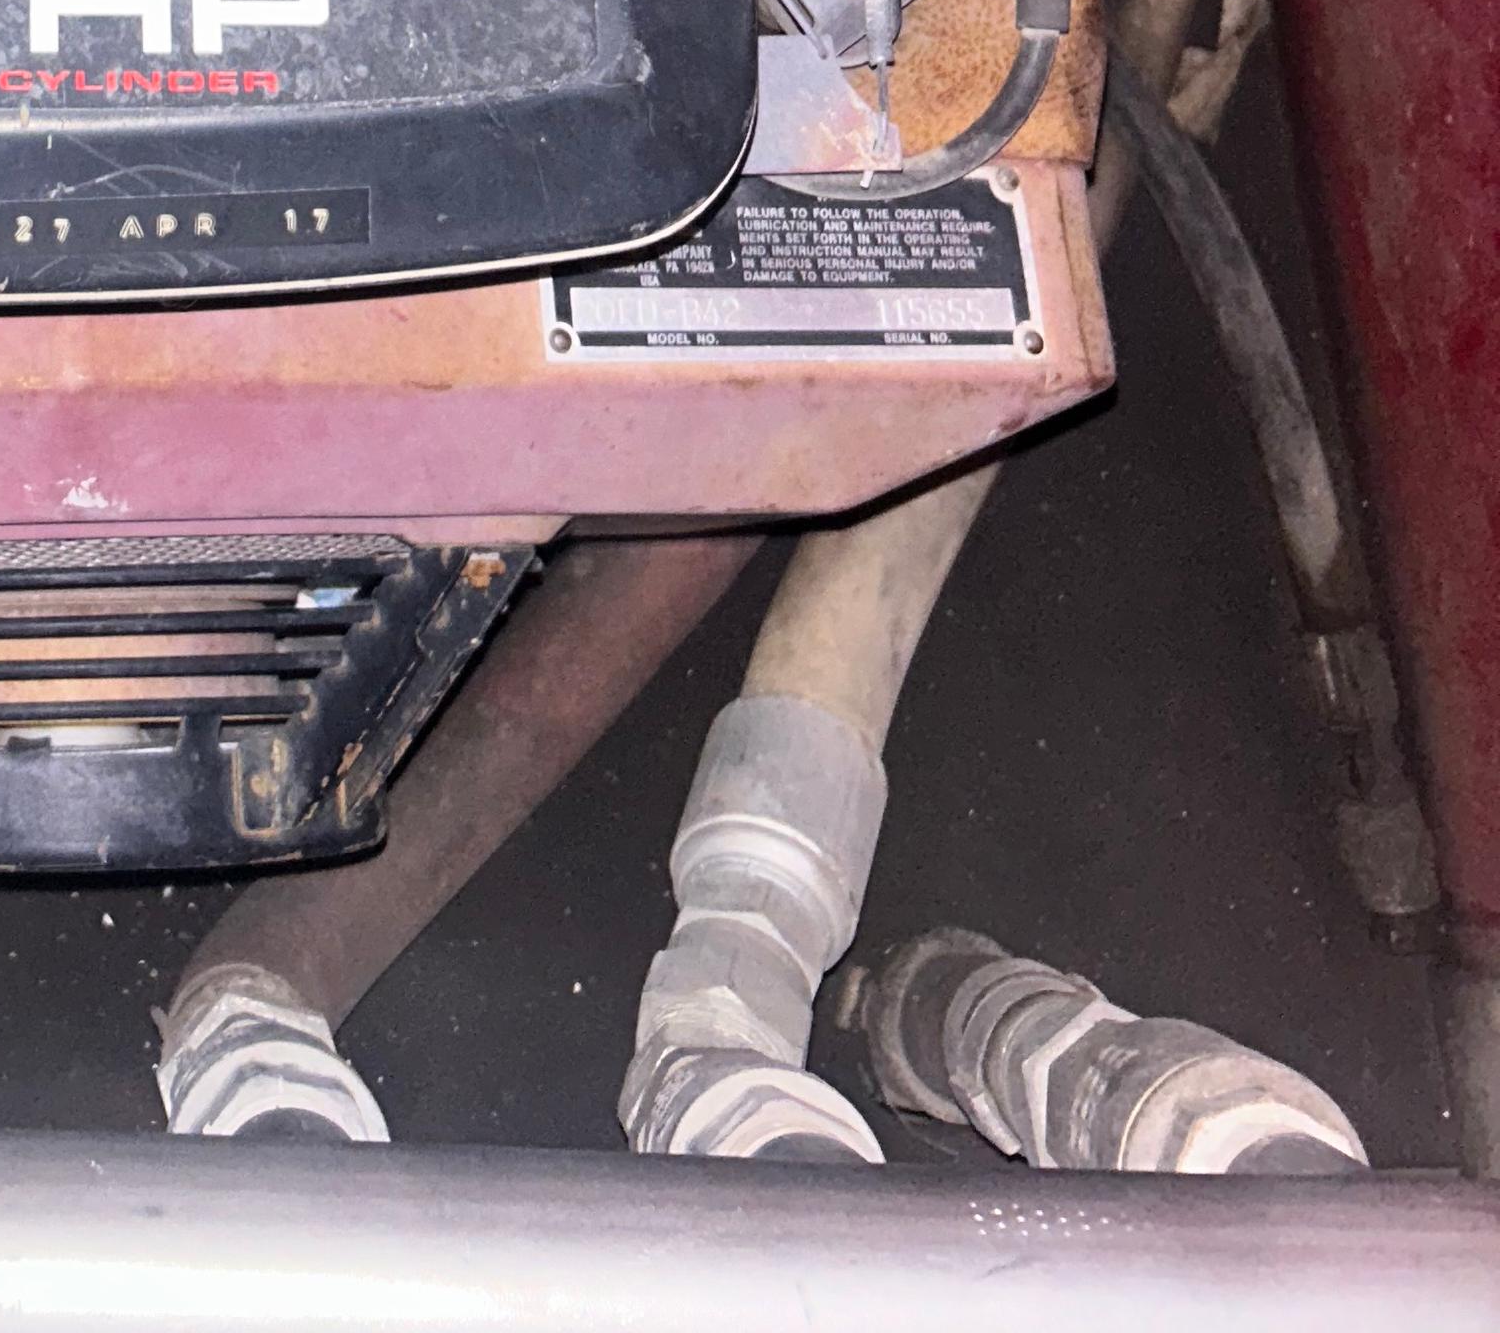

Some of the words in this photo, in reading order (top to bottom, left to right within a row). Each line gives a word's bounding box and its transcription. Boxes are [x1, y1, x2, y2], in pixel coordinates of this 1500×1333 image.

[0, 69, 280, 94] CYLINDER
[736, 207, 786, 219] FAILURE
[791, 208, 807, 219] TO
[813, 208, 861, 219] FOLLOW
[866, 208, 889, 220] THE
[14, 214, 71, 245] 27
[118, 211, 217, 240] APR
[283, 207, 331, 234] 17
[738, 220, 817, 231] LUBRICATION
[824, 220, 848, 231] AND
[853, 220, 935, 232] MAINTENANCE
[739, 232, 780, 243] MENTS
[786, 233, 807, 243] SET
[813, 233, 853, 243] FORTH
[858, 233, 870, 244] IN
[877, 233, 899, 244] THE
[904, 233, 970, 244] OPERATING
[659, 244, 713, 259] OMPANY
[741, 245, 766, 256] AND
[772, 246, 851, 256] INSTRUCTION
[857, 246, 905, 256] MANUAL
[911, 246, 935, 256] MAY
[940, 247, 984, 257] RESULT
[665, 261, 679, 273] PA
[742, 258, 755, 268] IN
[761, 258, 812, 269] SERIOUS
[817, 258, 879, 269] PERSONAL
[885, 259, 925, 269] INJURY
[932, 259, 976, 269] AND/OR
[639, 274, 661, 286] USA
[743, 270, 795, 281] DAMAGE
[800, 271, 816, 281] TO
[646, 333, 691, 344] MODEL
[696, 333, 719, 345] NO.
[884, 332, 925, 344] SERIAL
[929, 333, 952, 344] NO.
